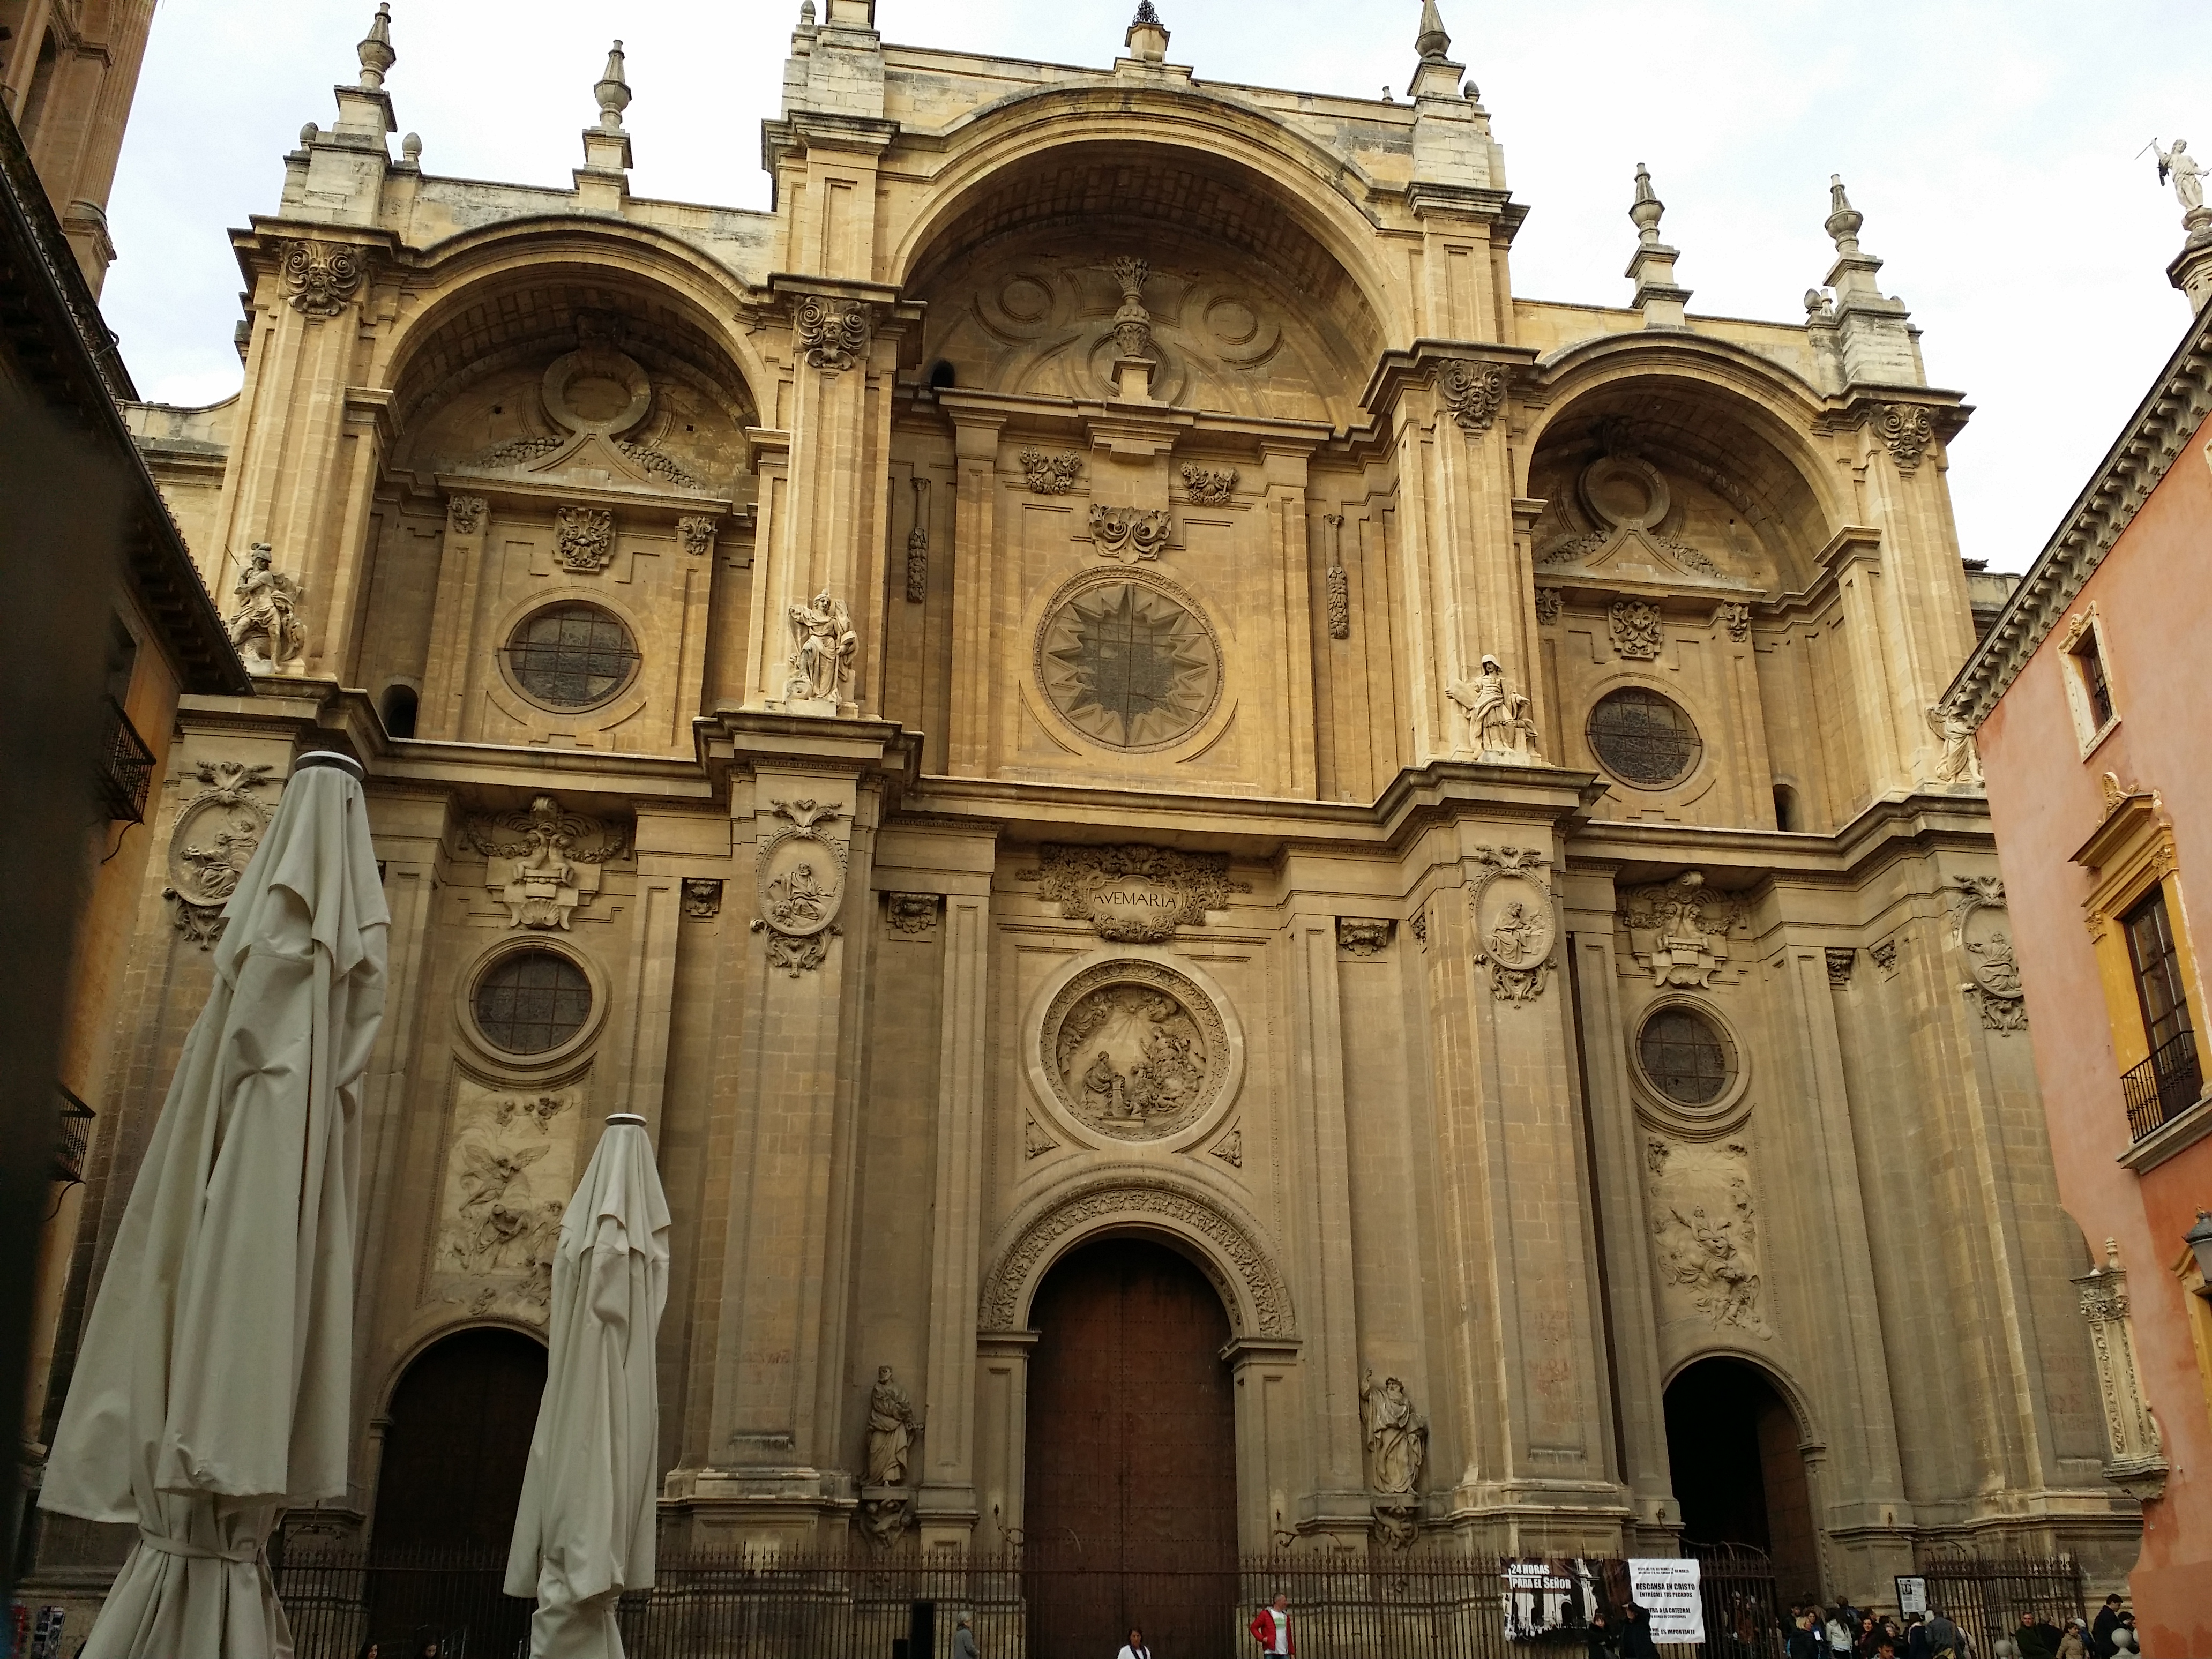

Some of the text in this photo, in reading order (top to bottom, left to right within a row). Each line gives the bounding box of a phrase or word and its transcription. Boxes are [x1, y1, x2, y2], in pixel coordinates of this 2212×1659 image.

[1511, 1564, 1550, 1575] 24 HORAS
[1512, 1576, 1571, 1589] PARA EL SEÑOR
